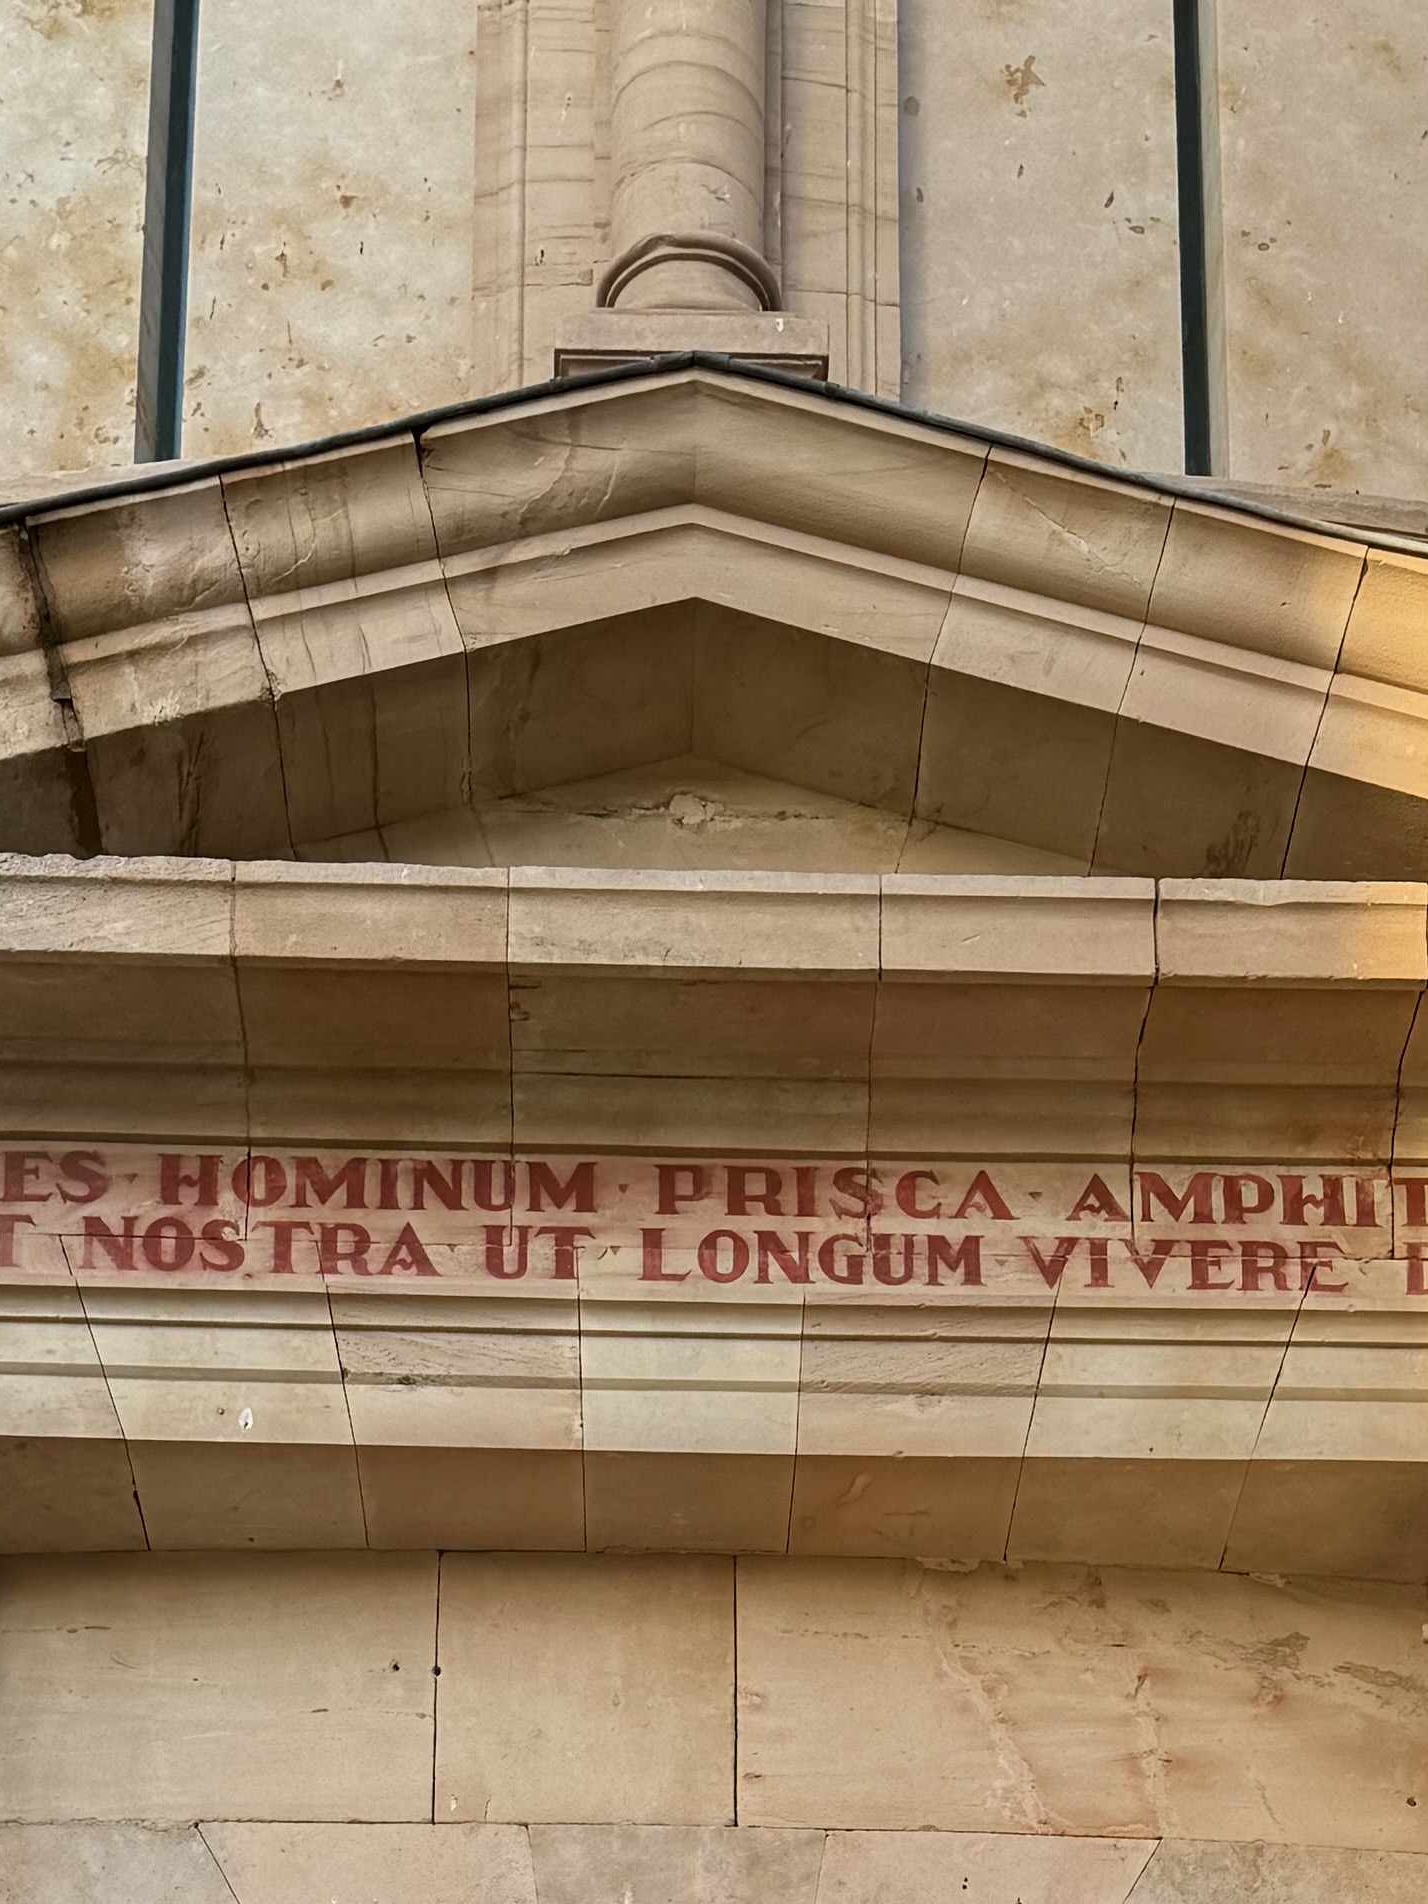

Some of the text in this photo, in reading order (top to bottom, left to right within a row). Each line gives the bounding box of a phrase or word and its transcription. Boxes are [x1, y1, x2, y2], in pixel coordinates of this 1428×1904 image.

[156, 1153, 599, 1214] HOMINUM
[653, 1163, 1022, 1221] PRISCA
[78, 1214, 444, 1278] NOSTRA
[481, 1223, 598, 1281] UT
[636, 1227, 988, 1287] LONGUM
[1017, 1235, 1352, 1294] VIVERE
